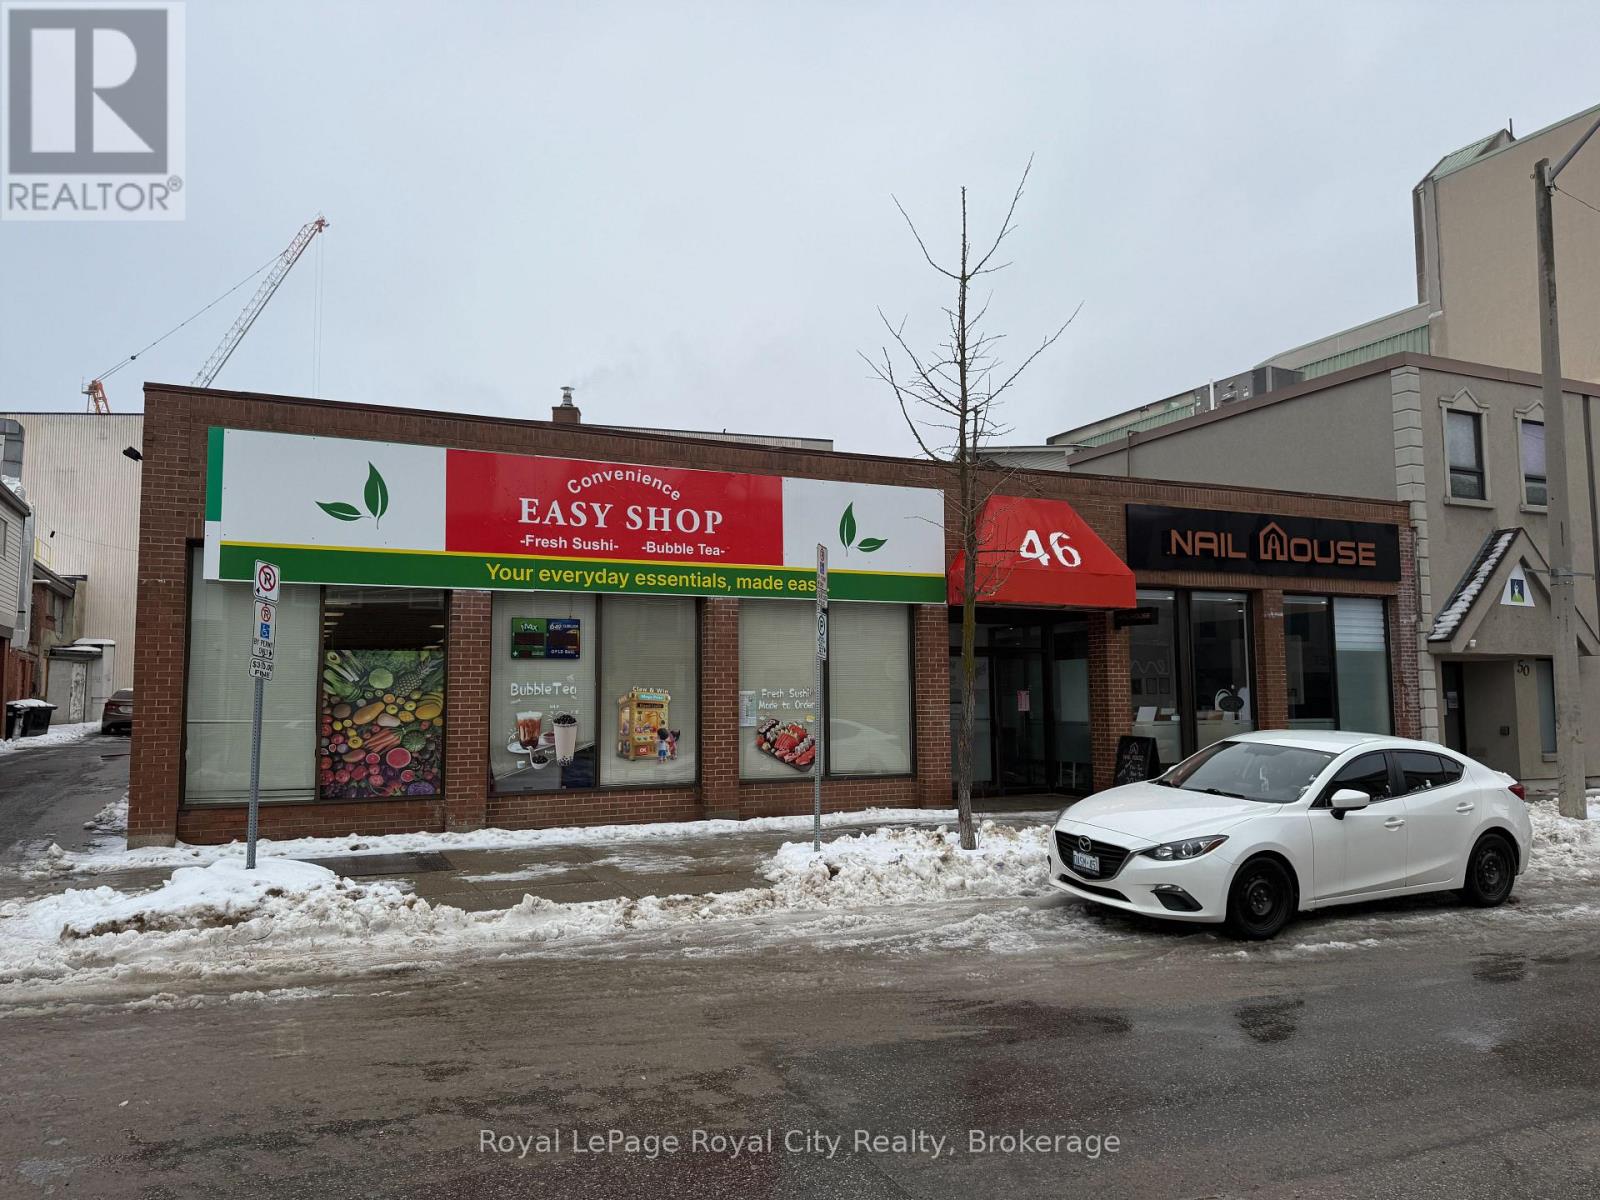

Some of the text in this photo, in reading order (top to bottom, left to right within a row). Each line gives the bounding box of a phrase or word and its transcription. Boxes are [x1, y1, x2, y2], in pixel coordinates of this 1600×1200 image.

[567, 469, 681, 501] Convenience
[518, 497, 724, 535] EASY SHOP
[1019, 529, 1082, 567] 46
[1169, 528, 1247, 559] NAIL
[485, 563, 534, 582] Your
[538, 568, 629, 588] everyday
[635, 573, 731, 592] essentials,
[736, 575, 784, 591] made
[1516, 659, 1530, 677] 50
[761, 688, 784, 699] Fresh
